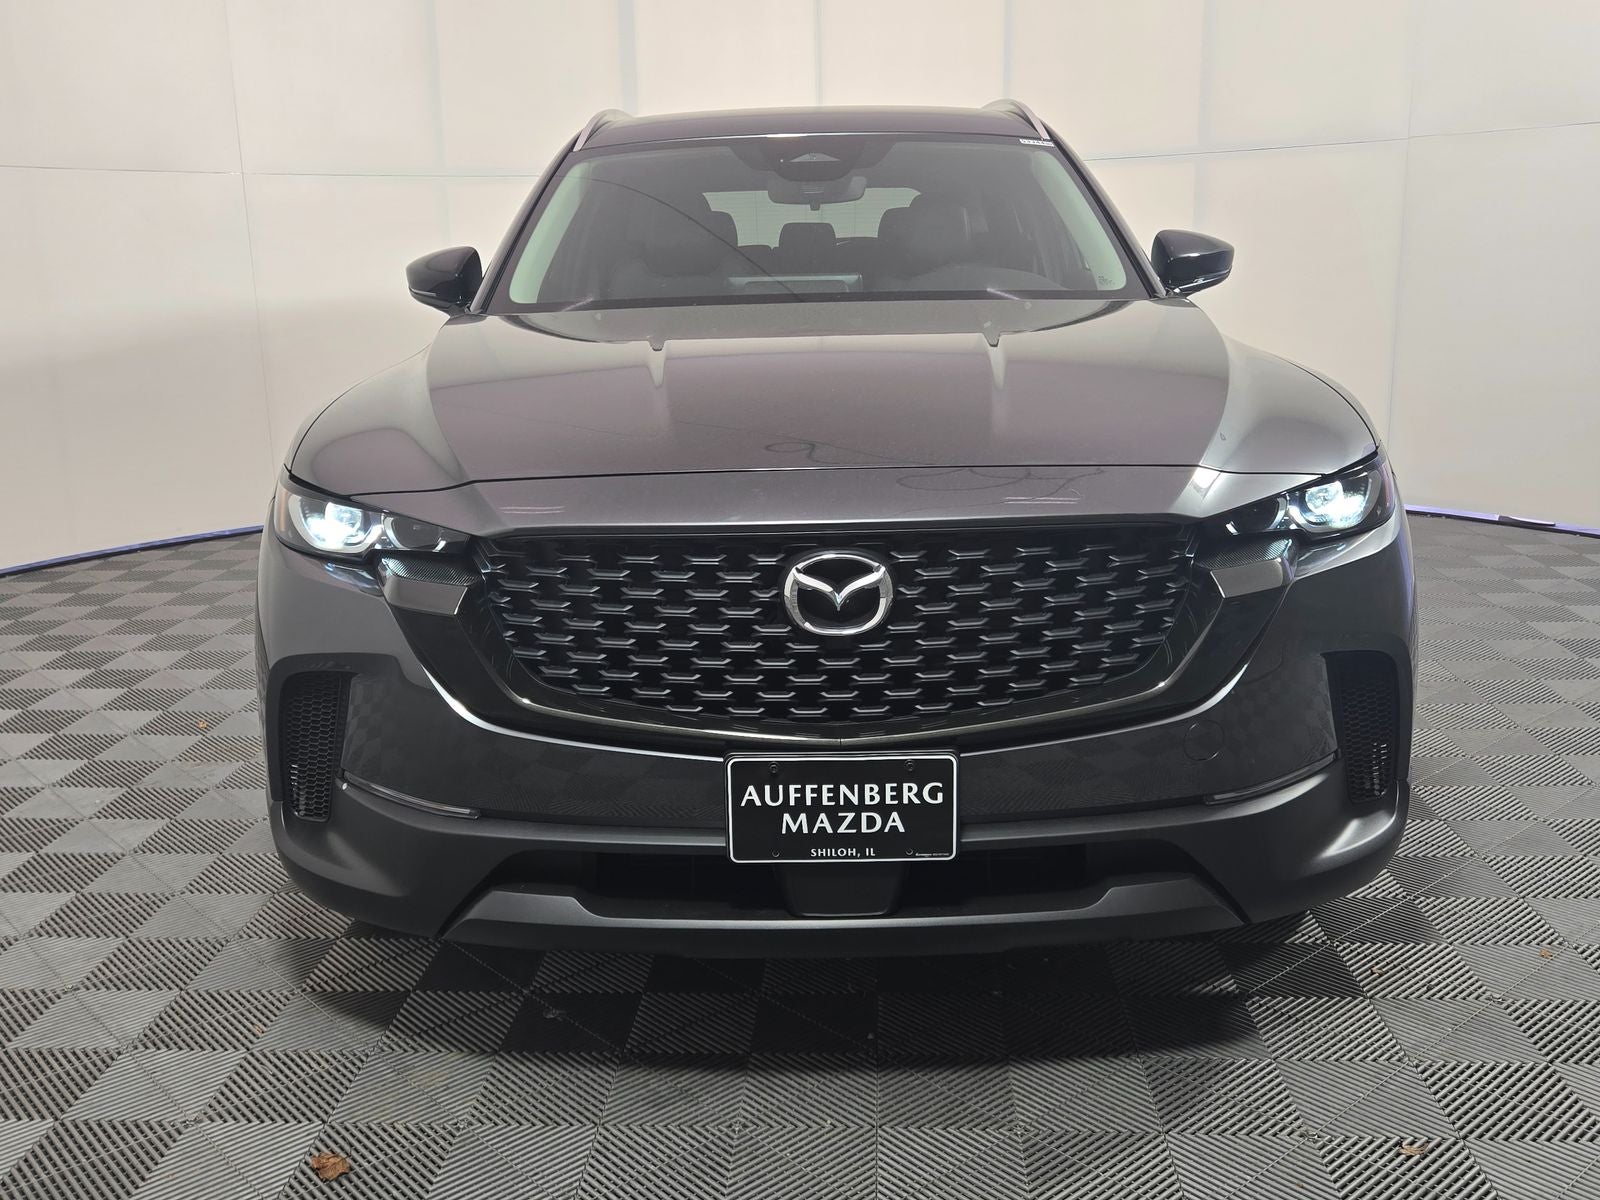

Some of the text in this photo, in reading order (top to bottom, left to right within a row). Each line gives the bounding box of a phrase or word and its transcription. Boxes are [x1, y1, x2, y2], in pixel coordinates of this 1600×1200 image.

[740, 782, 944, 807] AUFFENBERG
[781, 811, 905, 834] MAZDA
[810, 847, 876, 858] SHILOH, IL
